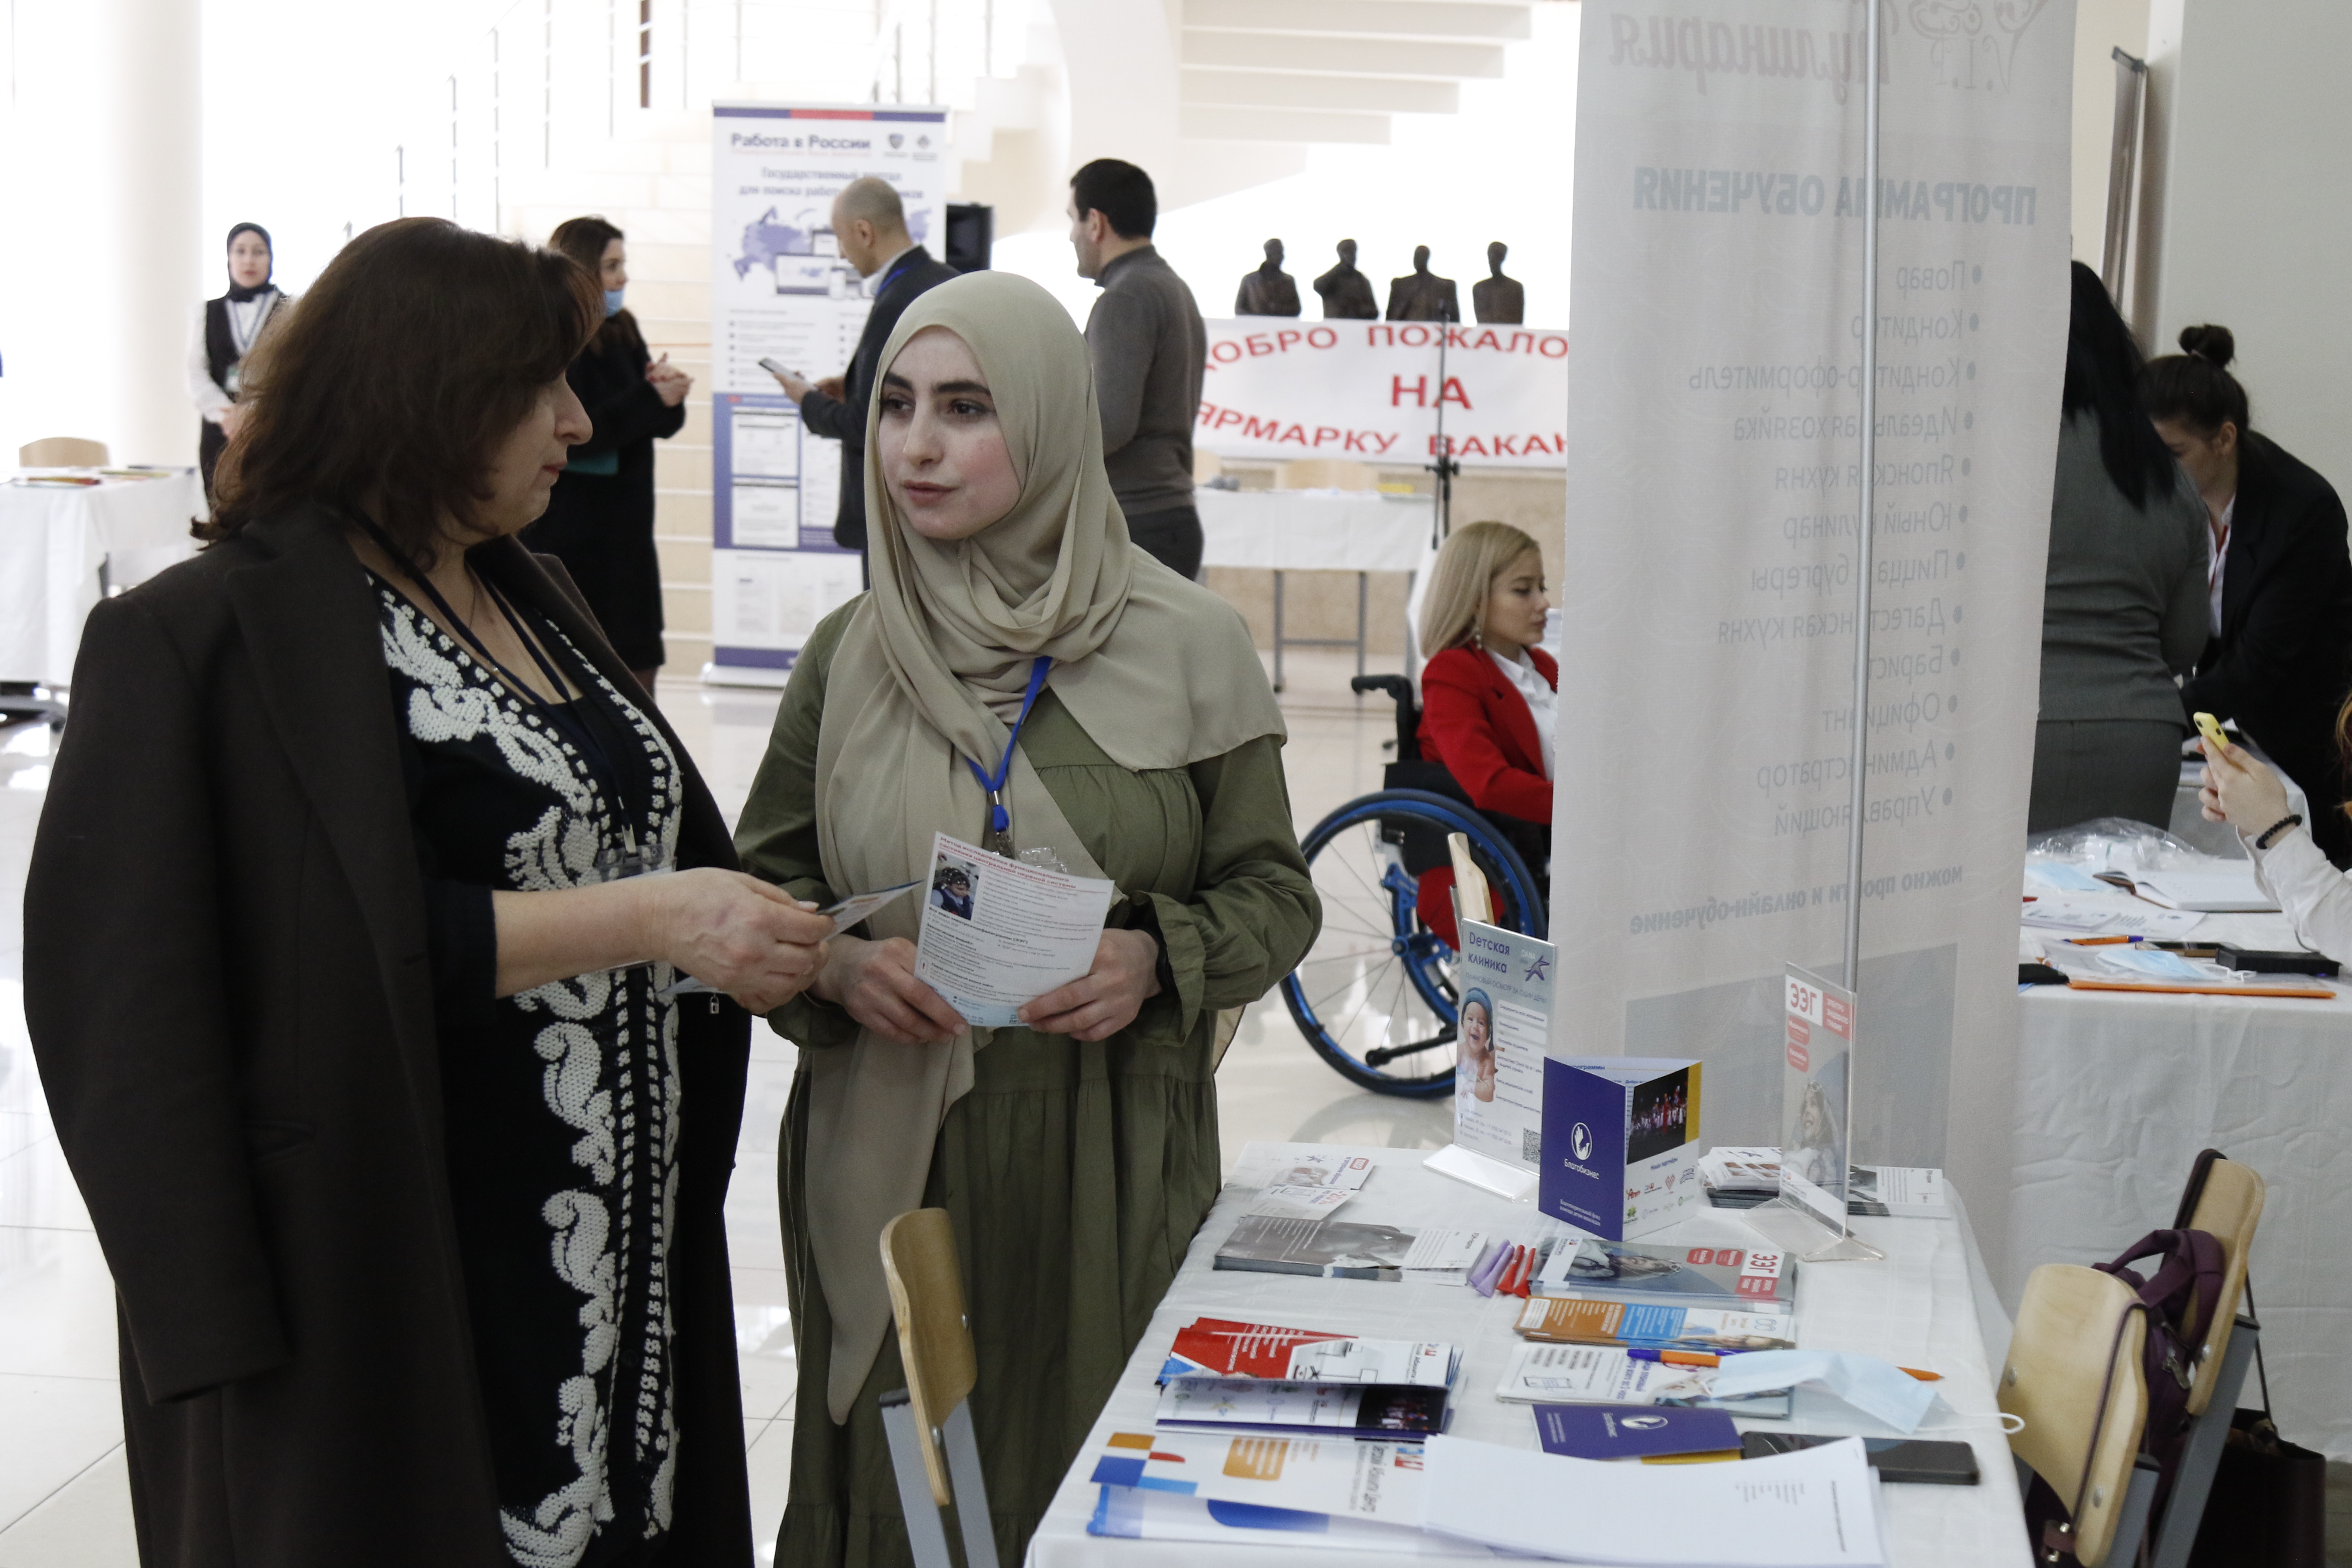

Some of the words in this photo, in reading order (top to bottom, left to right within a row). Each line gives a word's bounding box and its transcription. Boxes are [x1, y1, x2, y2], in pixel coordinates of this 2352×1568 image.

[732, 133, 789, 147] Работа
[795, 138, 803, 147] в
[809, 134, 870, 148] России
[1205, 327, 1338, 371] ОБРО
[1391, 374, 1473, 410] НА
[963, 847, 1008, 865] исследования
[974, 857, 1016, 874] центральной
[1468, 953, 1507, 973] клиника
[1791, 983, 1817, 1015] ЭЭГ
[1564, 1158, 1599, 1179] Благобизнес
[1749, 1253, 1778, 1274] ЭЭГ
